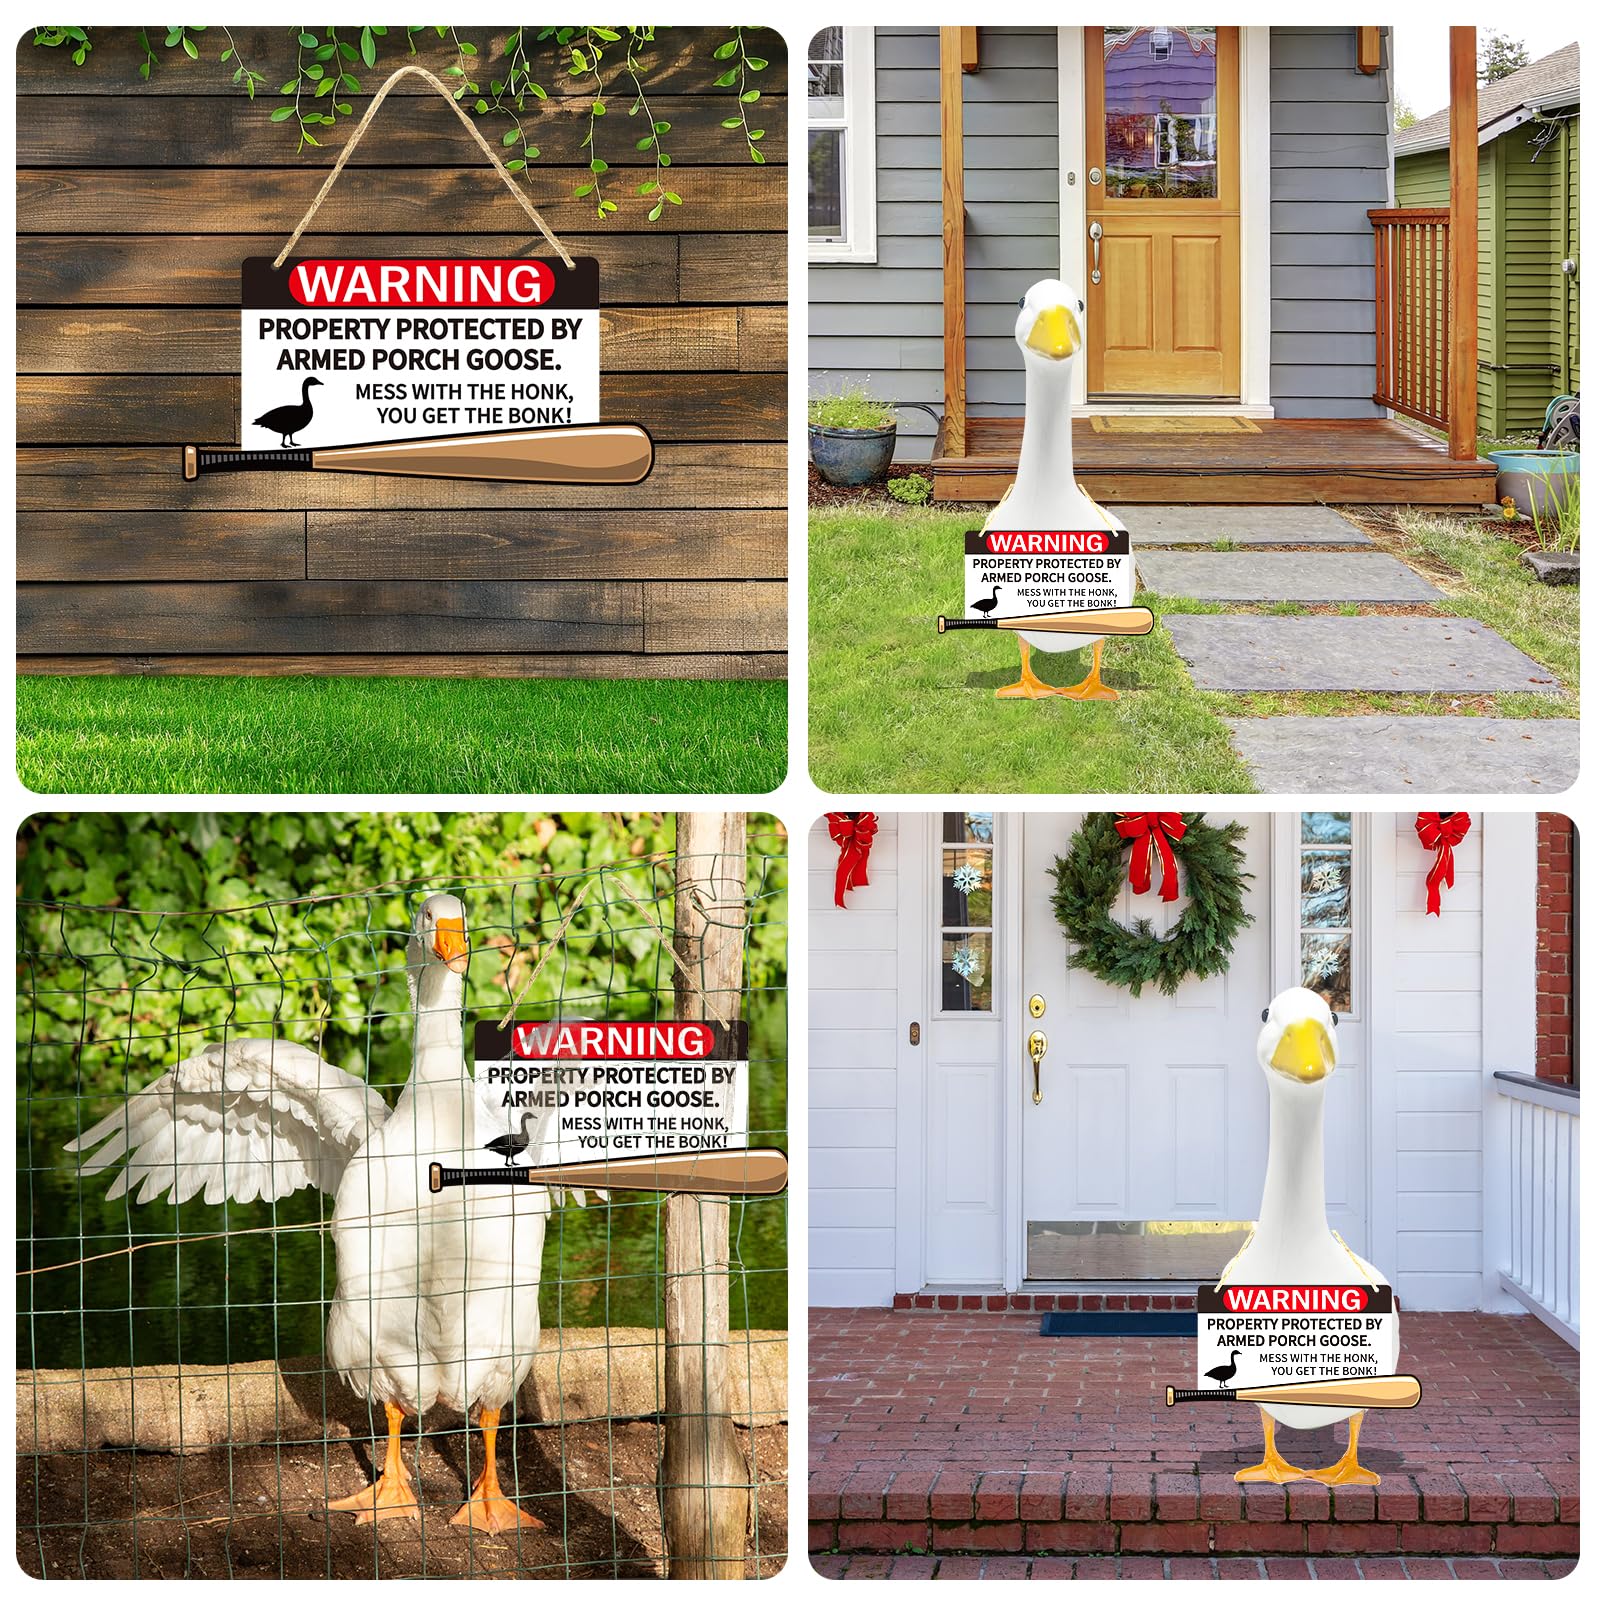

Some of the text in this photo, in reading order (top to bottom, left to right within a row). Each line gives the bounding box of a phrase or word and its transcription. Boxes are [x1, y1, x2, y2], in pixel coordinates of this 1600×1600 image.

[297, 265, 542, 303] WARNING
[260, 318, 583, 340] PROPERTY PROTECTED BY
[277, 349, 561, 370] ARMED PORCH GOOSE.
[357, 384, 573, 403] MESS WITH THE HONK,
[377, 408, 572, 424] YOU GET THE BONK!
[990, 534, 1103, 552] WARNING
[973, 559, 1121, 569] PROPERTY PROTECTED BY
[981, 573, 1111, 583] ARMED PORCH GOOSE.
[1018, 589, 1117, 597] MESS WITH THE HONK,
[1027, 600, 1117, 608] YOU GET THE BONK!
[517, 1027, 704, 1056] WARNING
[488, 1067, 735, 1084] PROPERTY PROTECTED BY
[502, 1090, 719, 1107] ARMED PORCH GOOSE.
[562, 1116, 729, 1132] MESS WITH THE HONK,
[578, 1135, 728, 1149] YOU GET THE BONK!
[1227, 1289, 1362, 1310] WARNING
[1208, 1318, 1382, 1330] PROPERTY PROTECTED BY
[1217, 1335, 1371, 1346] ARMED PORCH GOOSE.
[1260, 1354, 1377, 1364] MESS WITH THE HONK,
[1271, 1367, 1377, 1376] YOU GET THE BONK!
